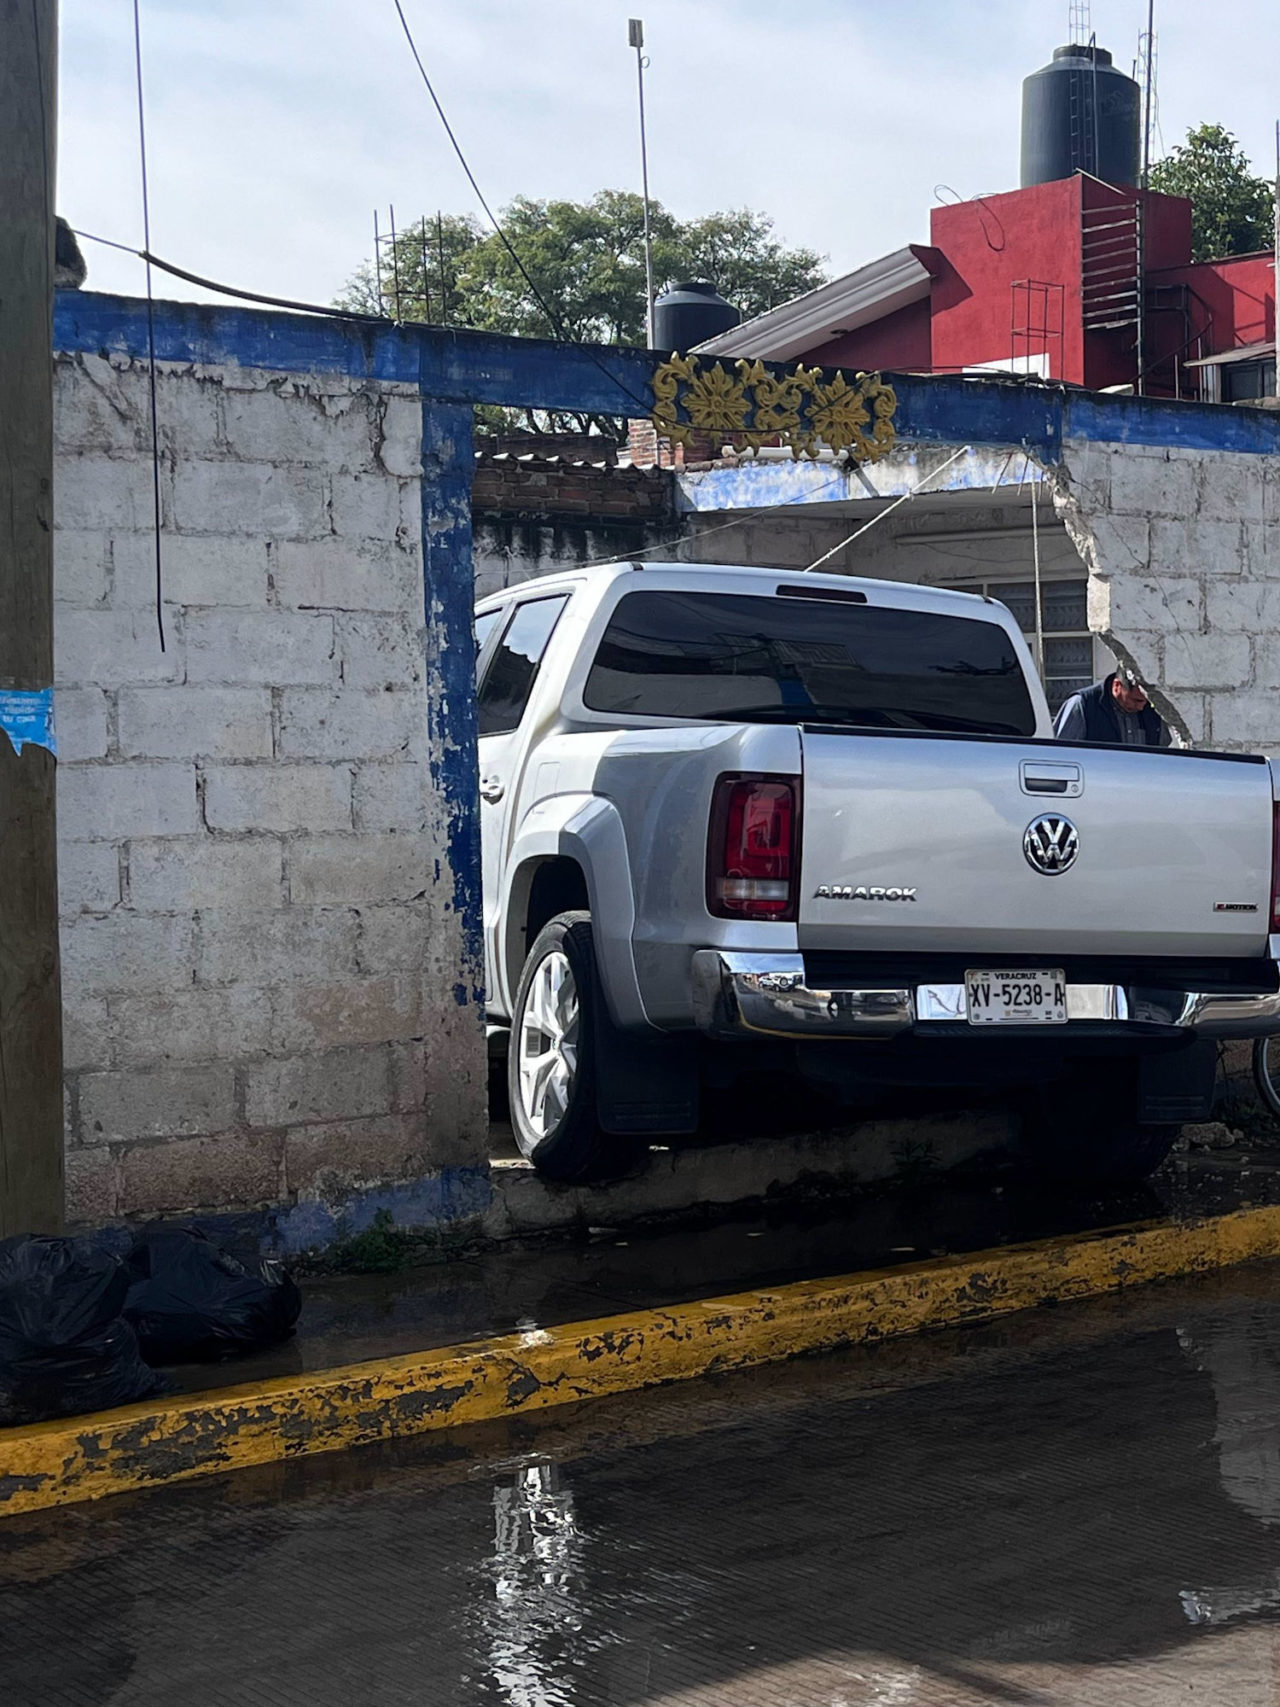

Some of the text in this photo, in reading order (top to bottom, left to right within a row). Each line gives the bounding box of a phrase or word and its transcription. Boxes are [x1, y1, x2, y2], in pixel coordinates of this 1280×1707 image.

[1024, 814, 1079, 874] VW
[812, 884, 917, 902] AMAROK
[994, 972, 1037, 980] VERACRUZ
[971, 983, 1063, 1007] XV-5238-A
